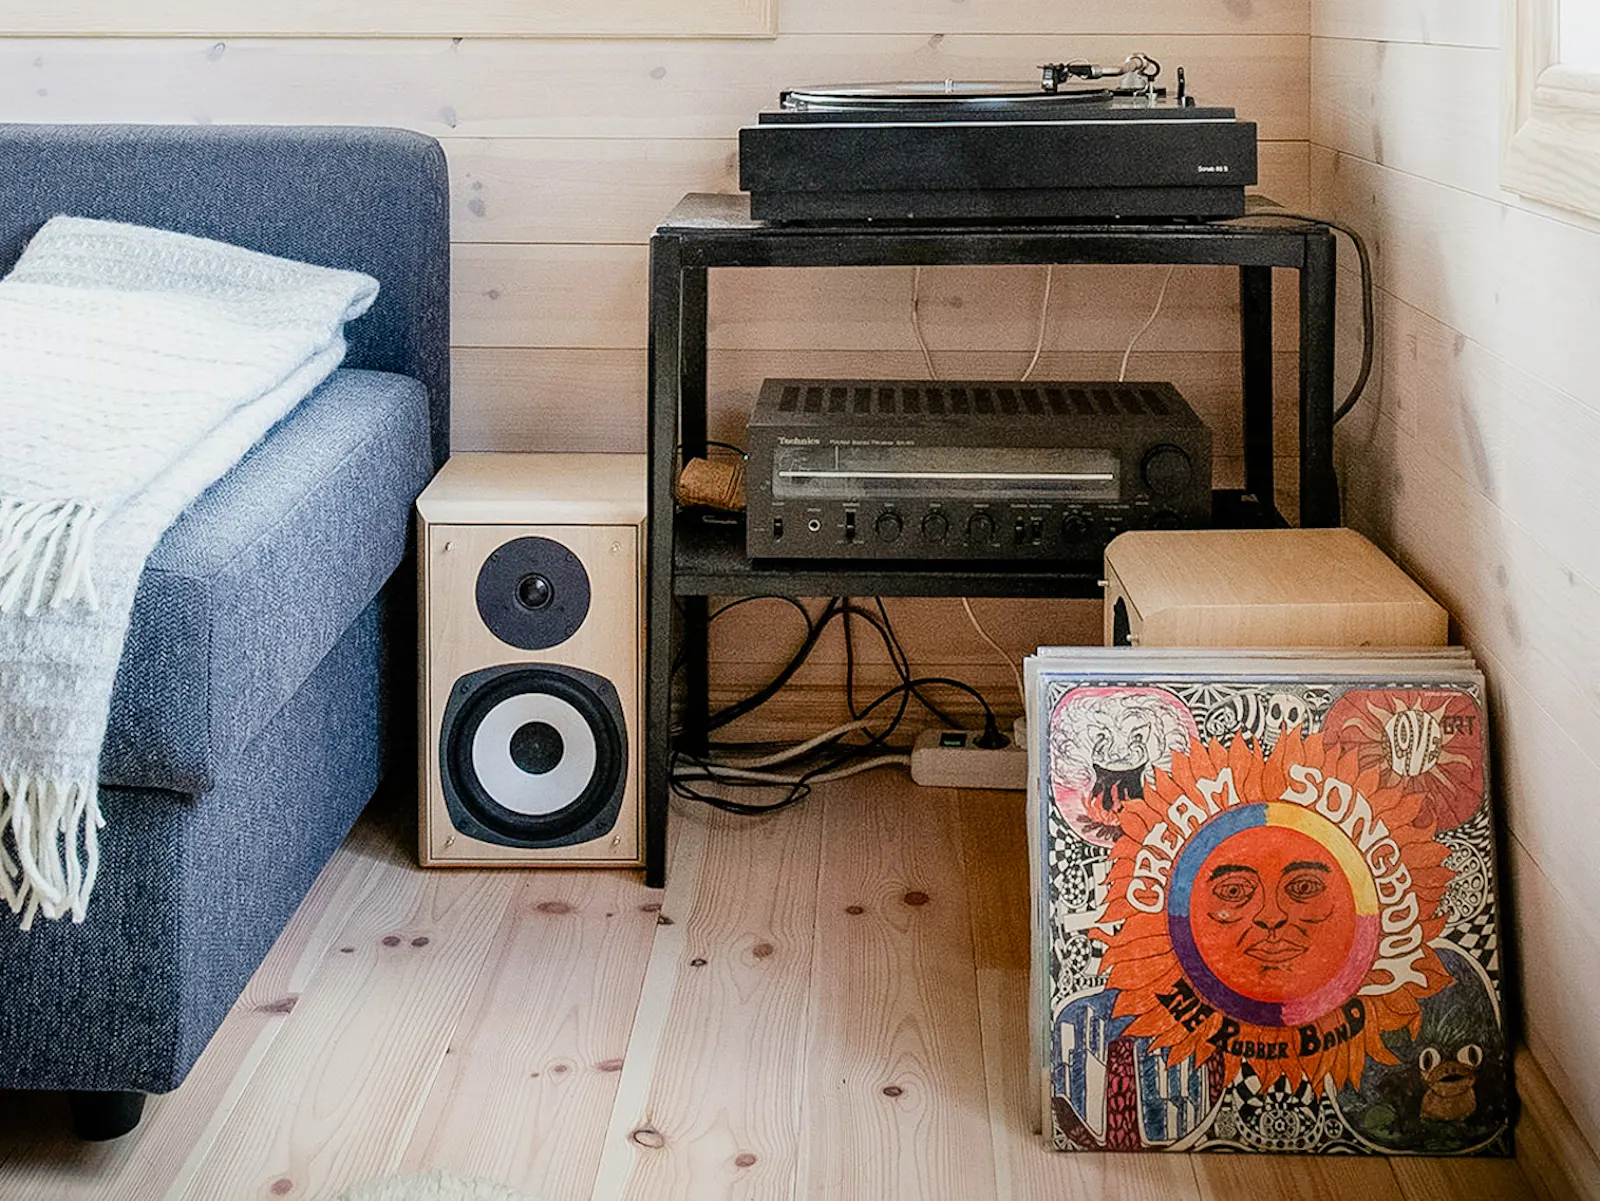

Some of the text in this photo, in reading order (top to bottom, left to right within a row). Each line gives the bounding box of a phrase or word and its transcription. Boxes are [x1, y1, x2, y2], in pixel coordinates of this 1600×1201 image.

[778, 437, 821, 445] Technics
[1384, 710, 1441, 777] LOVE
[1126, 763, 1427, 996] CREAM SONGBOOK
[1155, 977, 1366, 1059] THE RUBBER BAND
